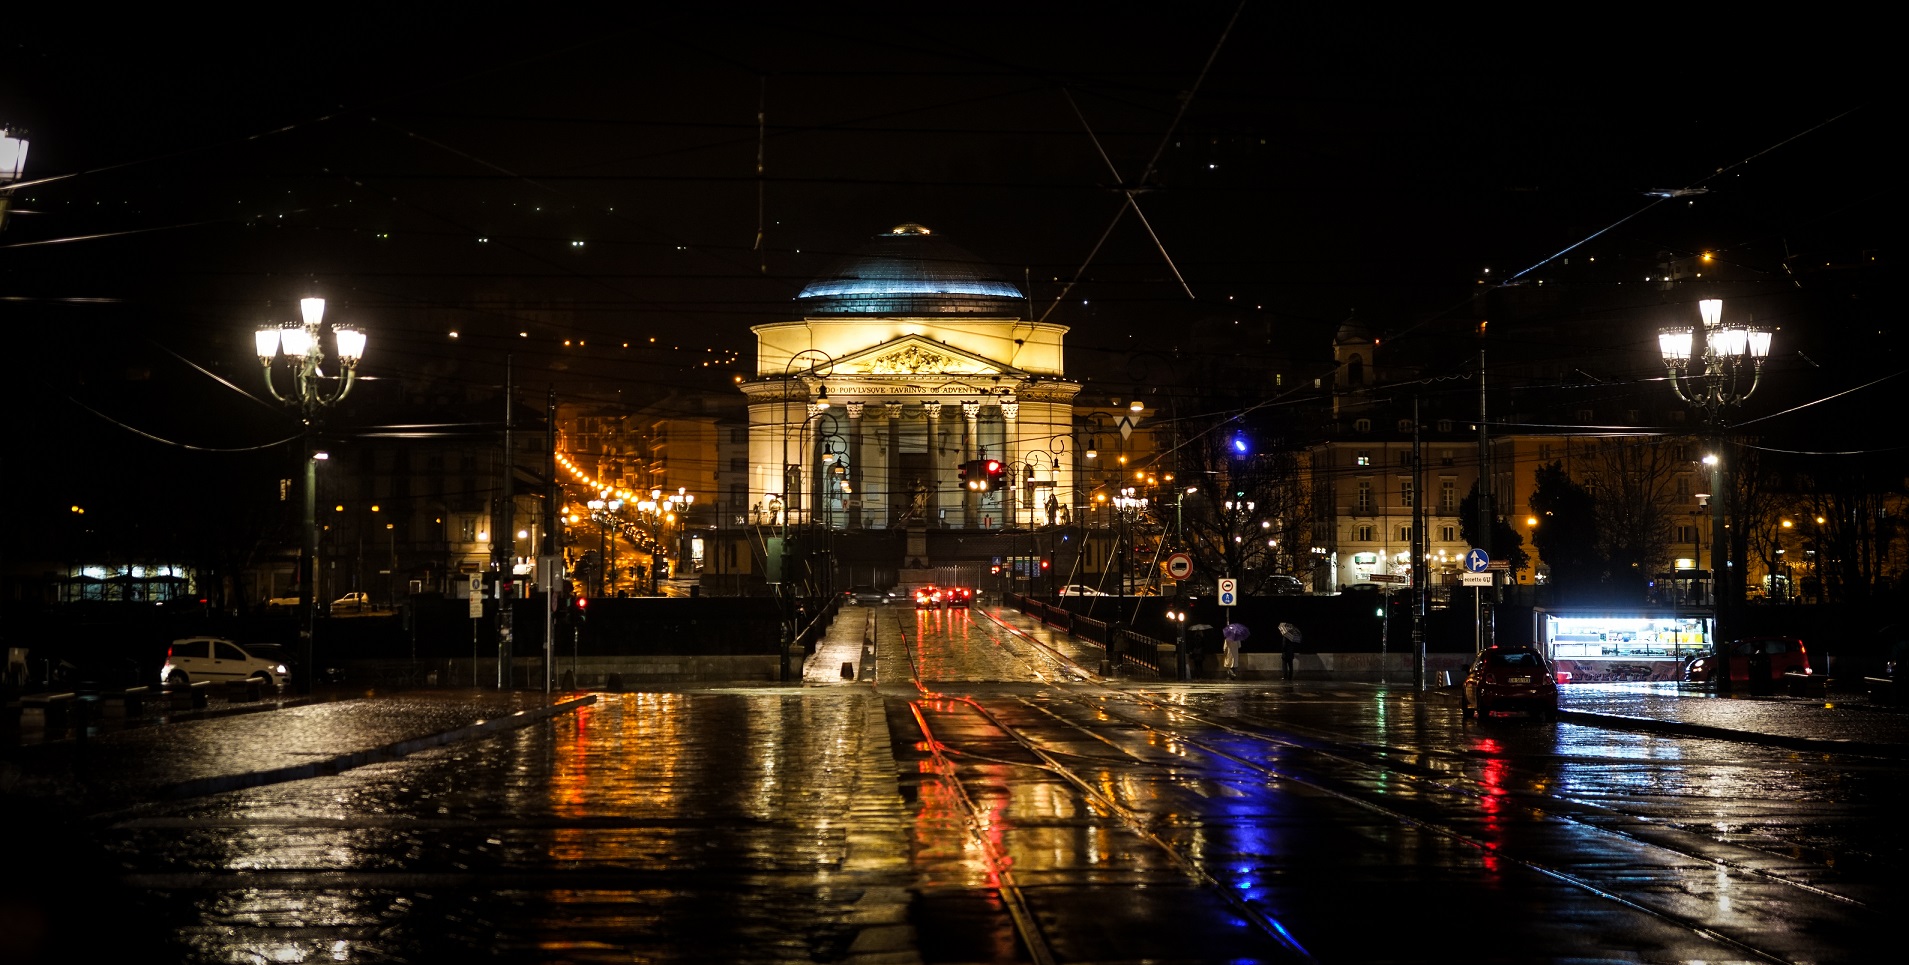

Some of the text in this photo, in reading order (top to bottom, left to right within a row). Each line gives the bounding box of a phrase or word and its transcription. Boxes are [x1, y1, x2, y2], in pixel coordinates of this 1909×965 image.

[815, 386, 836, 394] ODO
[839, 386, 886, 394] POPVLVSQVE
[889, 386, 927, 394] TAVRINVS
